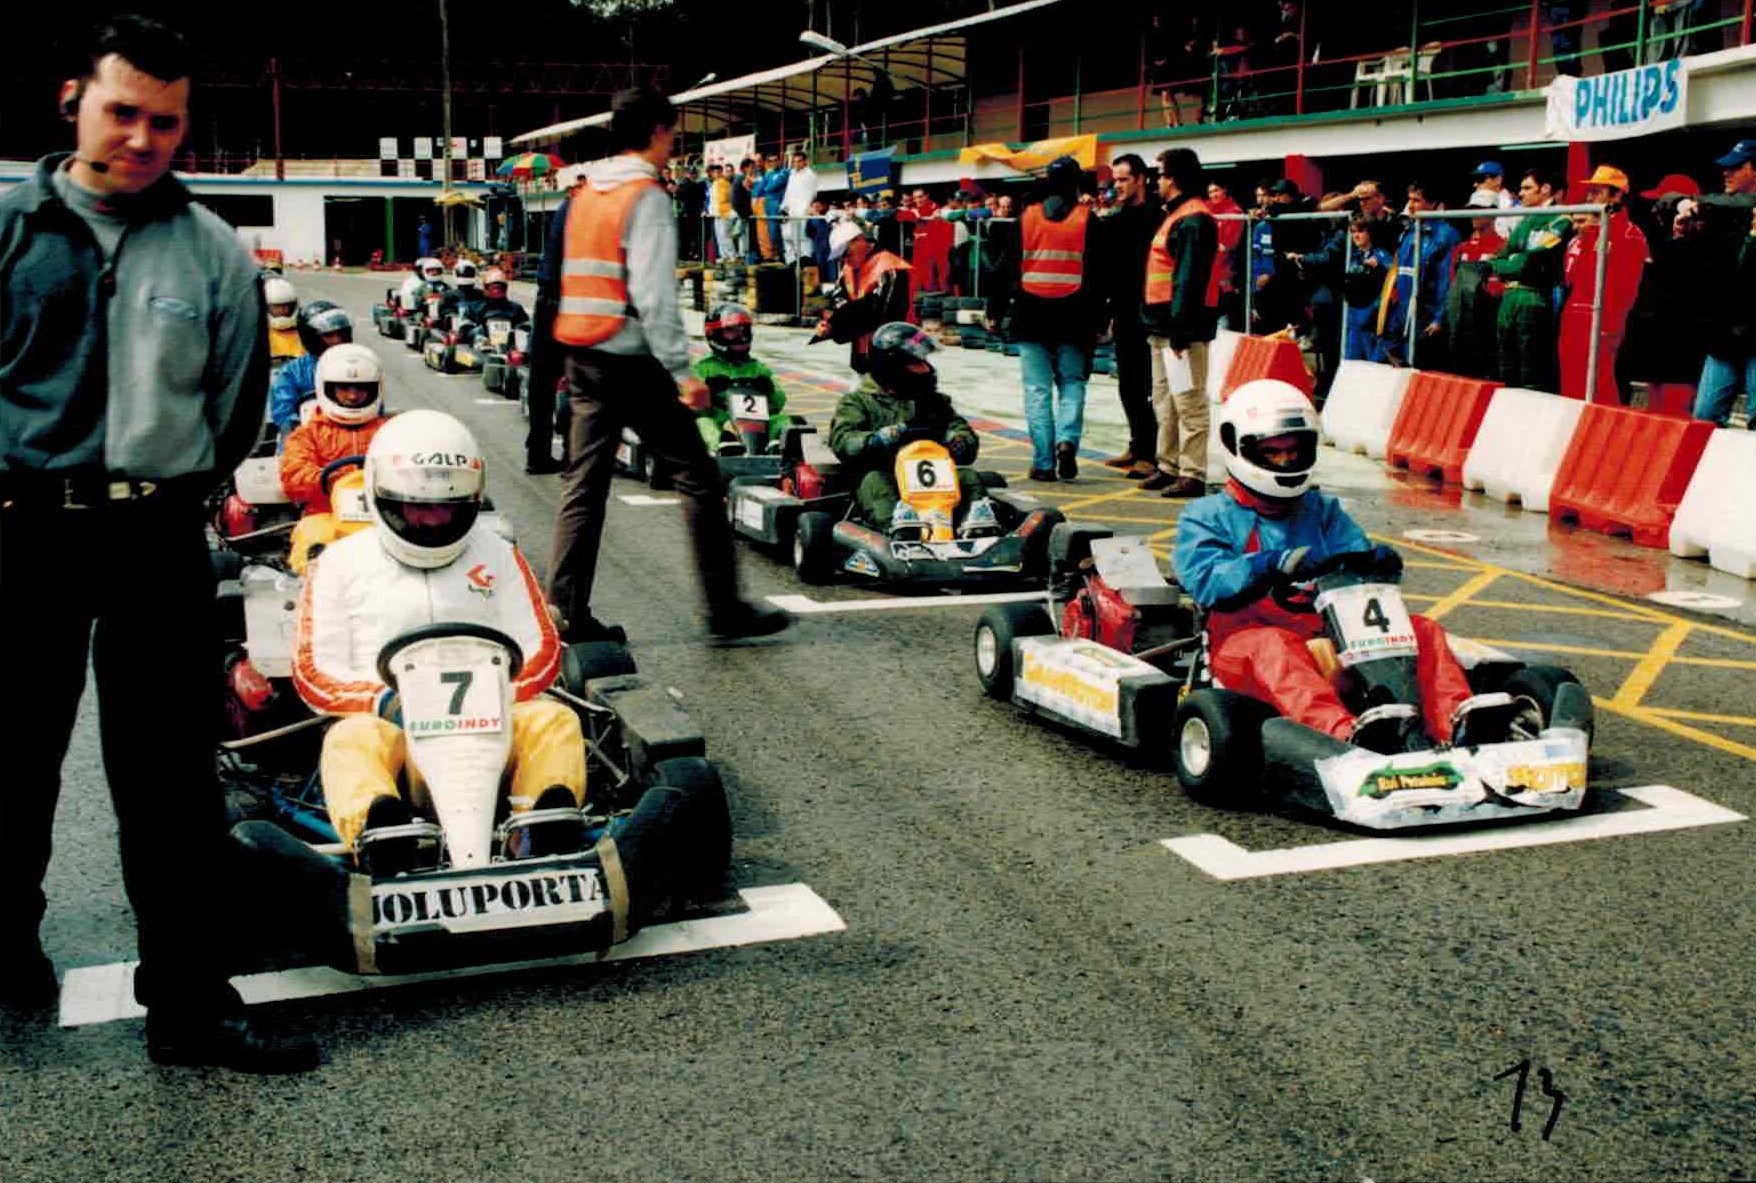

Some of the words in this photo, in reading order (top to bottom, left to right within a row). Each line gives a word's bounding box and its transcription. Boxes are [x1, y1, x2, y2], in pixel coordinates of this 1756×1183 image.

[1574, 57, 1681, 128] PHILIPS
[743, 395, 758, 413] 2
[917, 460, 936, 488] 6
[1363, 598, 1390, 633] 4
[440, 671, 473, 715] 7
